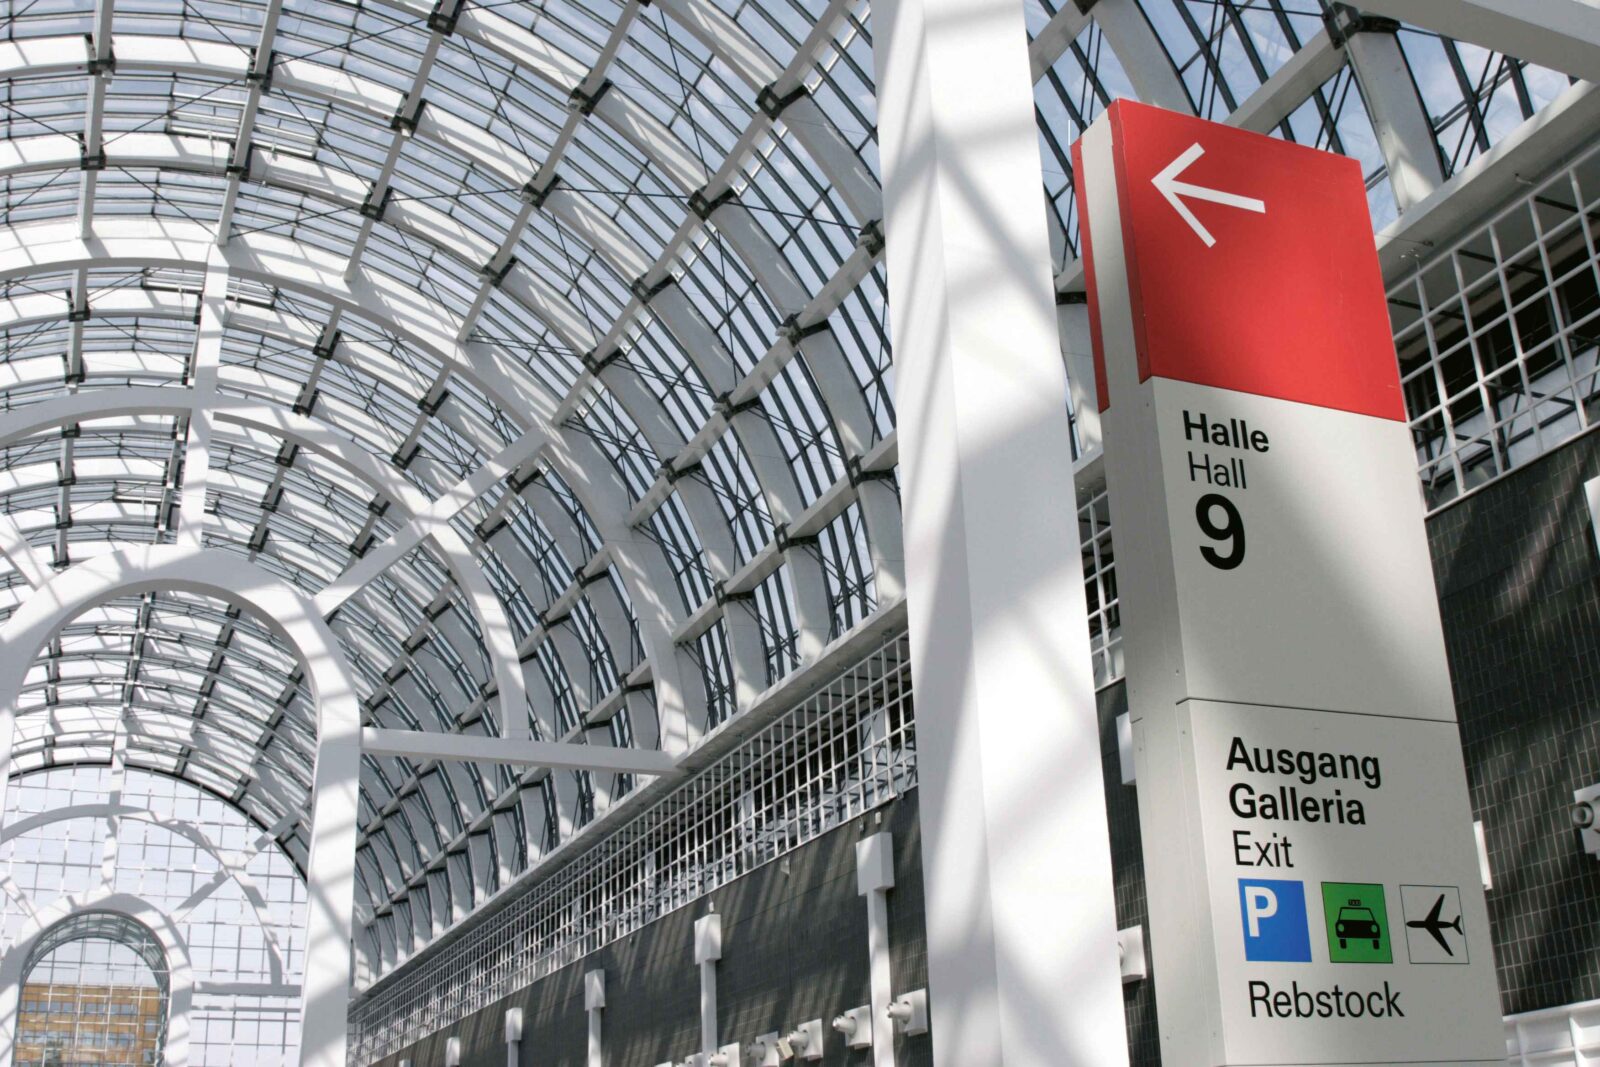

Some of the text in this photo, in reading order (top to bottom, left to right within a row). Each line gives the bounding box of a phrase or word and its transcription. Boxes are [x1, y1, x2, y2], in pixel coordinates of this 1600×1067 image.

[1183, 410, 1270, 453] Halle
[1187, 451, 1247, 490] Hall
[1195, 493, 1246, 570] 9
[1226, 736, 1382, 790] Ausgang
[1229, 782, 1366, 826] Galleria
[1232, 830, 1294, 868] Exit
[1244, 886, 1278, 937] P
[1248, 980, 1405, 1018] Rebstock
